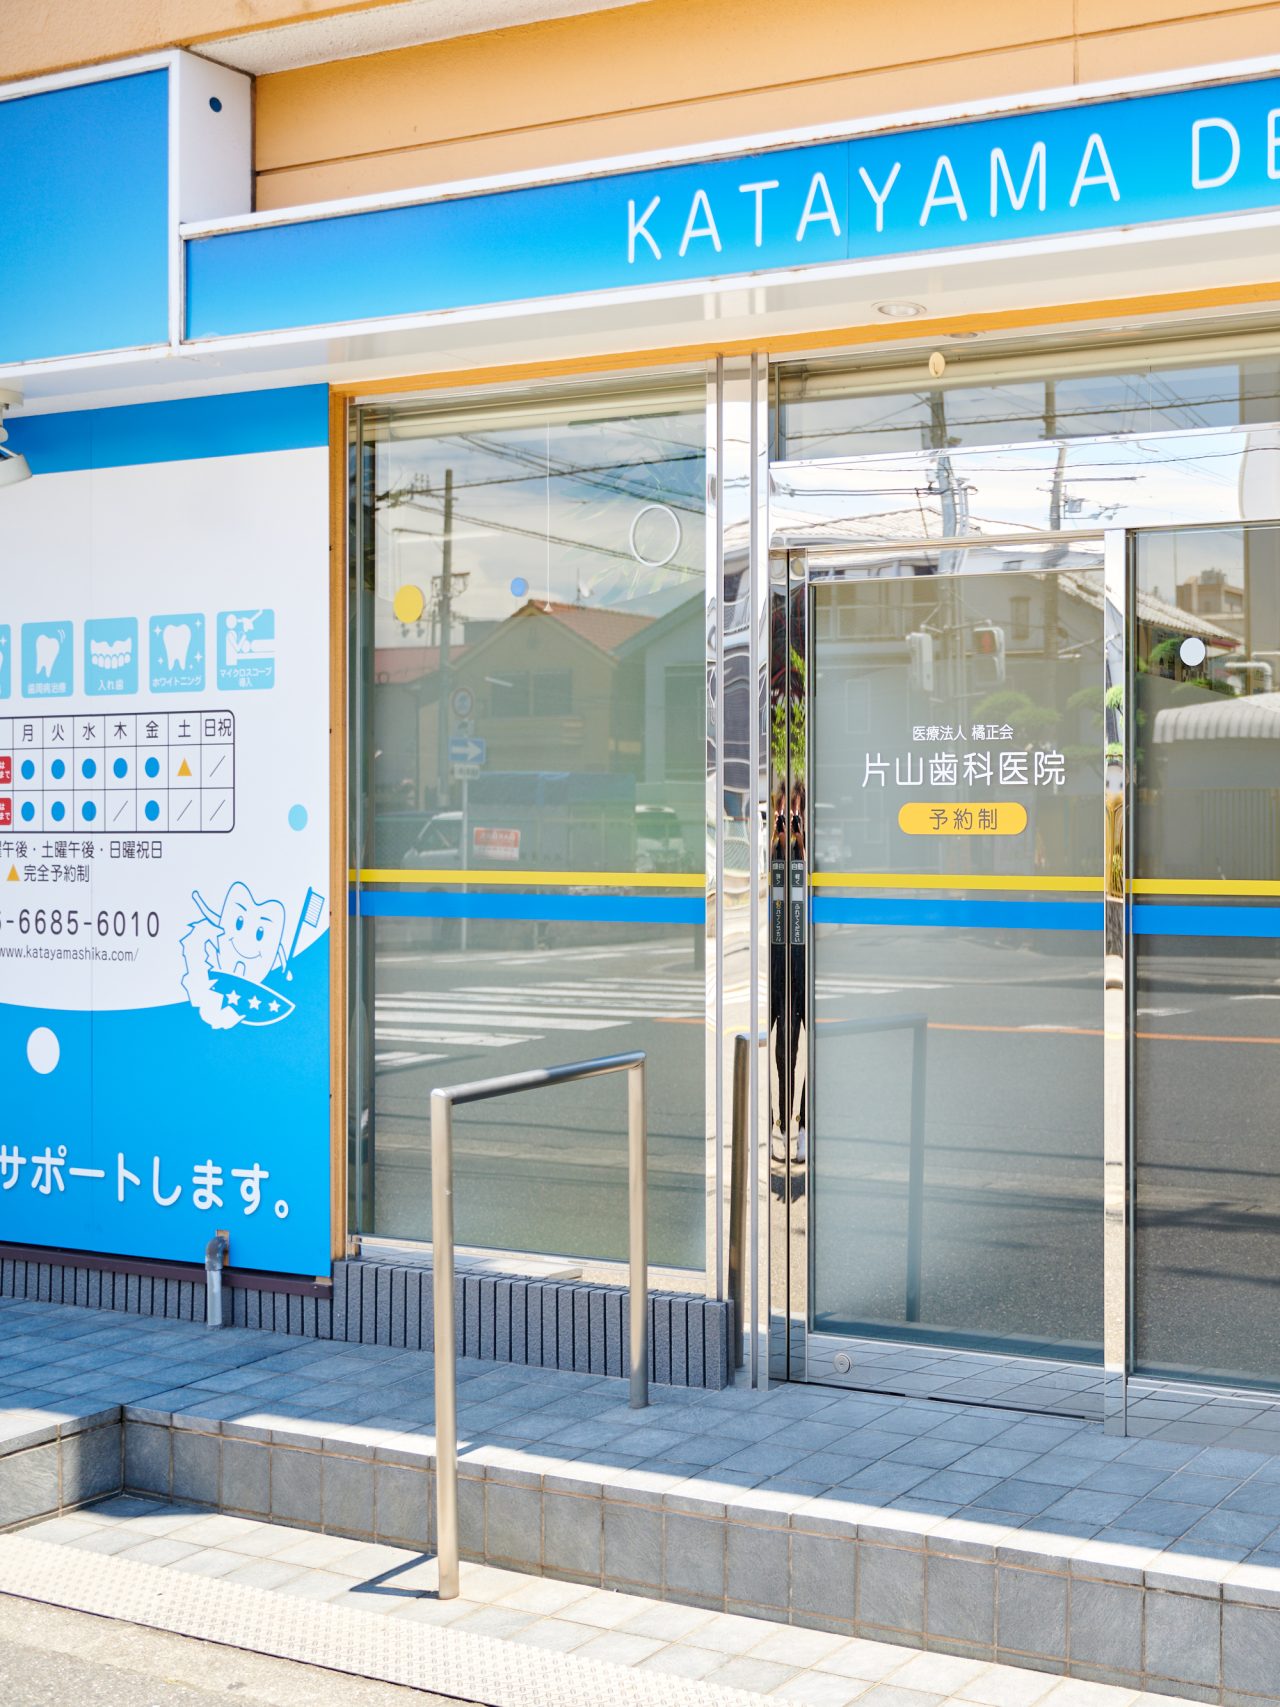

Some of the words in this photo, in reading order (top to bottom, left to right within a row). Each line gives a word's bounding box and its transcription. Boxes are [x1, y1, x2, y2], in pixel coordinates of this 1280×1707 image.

[628, 133, 1120, 264] KATAYAMA
[152, 676, 202, 688] ホワイトニング
[220, 667, 273, 678] マイクロスコープ
[22, 723, 34, 742] 月
[51, 723, 65, 742] 火
[82, 722, 96, 740] 水
[113, 721, 128, 739] 木
[145, 720, 159, 739] 金
[178, 719, 191, 738] 土
[204, 717, 232, 738] 日祝
[912, 725, 967, 742] 医療法人
[861, 749, 1066, 788] 片山歯科医院
[929, 808, 998, 830] 予約制
[0, 840, 162, 859] 午後・土曜午後・日曜祝日
[24, 864, 90, 883] 完全予約制
[0, 908, 160, 938] -6685-6010
[0, 1144, 290, 1219] サポートします。
